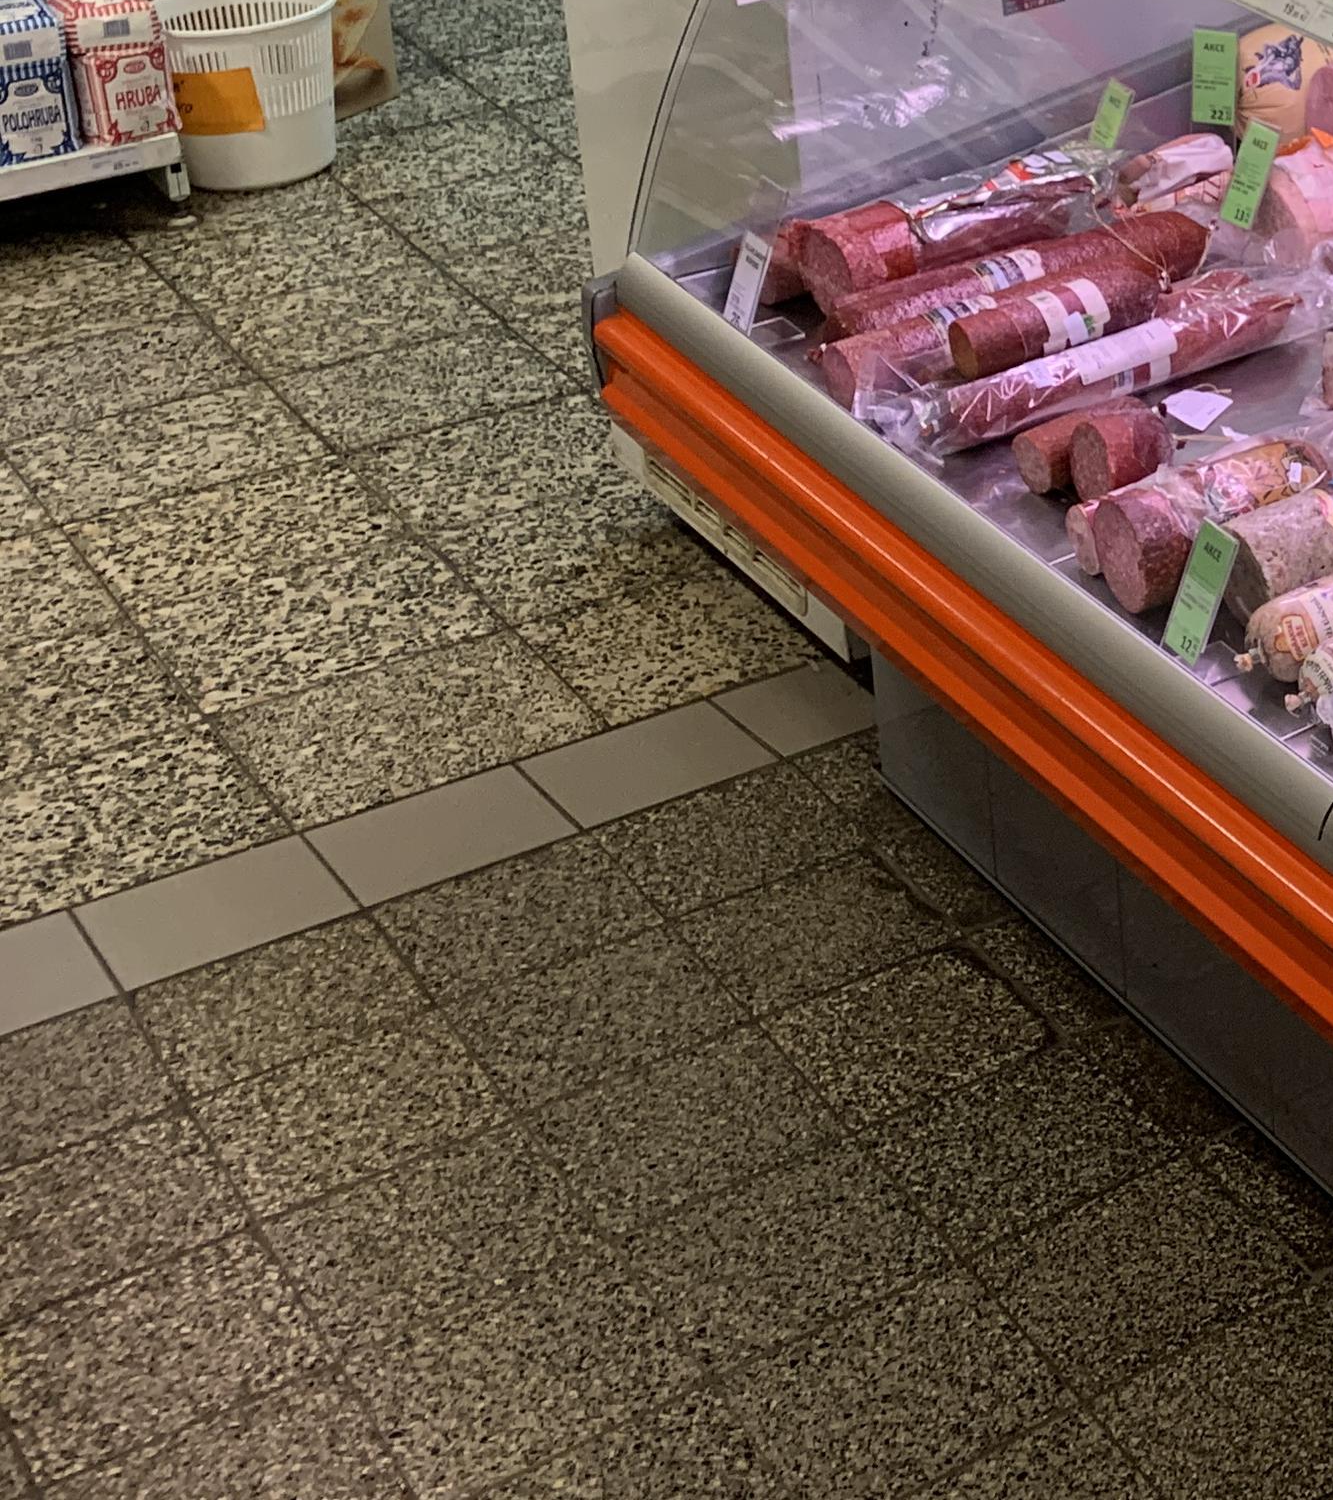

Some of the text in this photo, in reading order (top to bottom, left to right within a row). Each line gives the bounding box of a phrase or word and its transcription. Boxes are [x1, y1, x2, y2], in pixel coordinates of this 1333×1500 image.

[1204, 43, 1225, 53] AKCE
[115, 78, 161, 110] HRUBÁ
[2, 101, 61, 133] POLOHRUBÁ
[1204, 542, 1222, 563] AKCE
